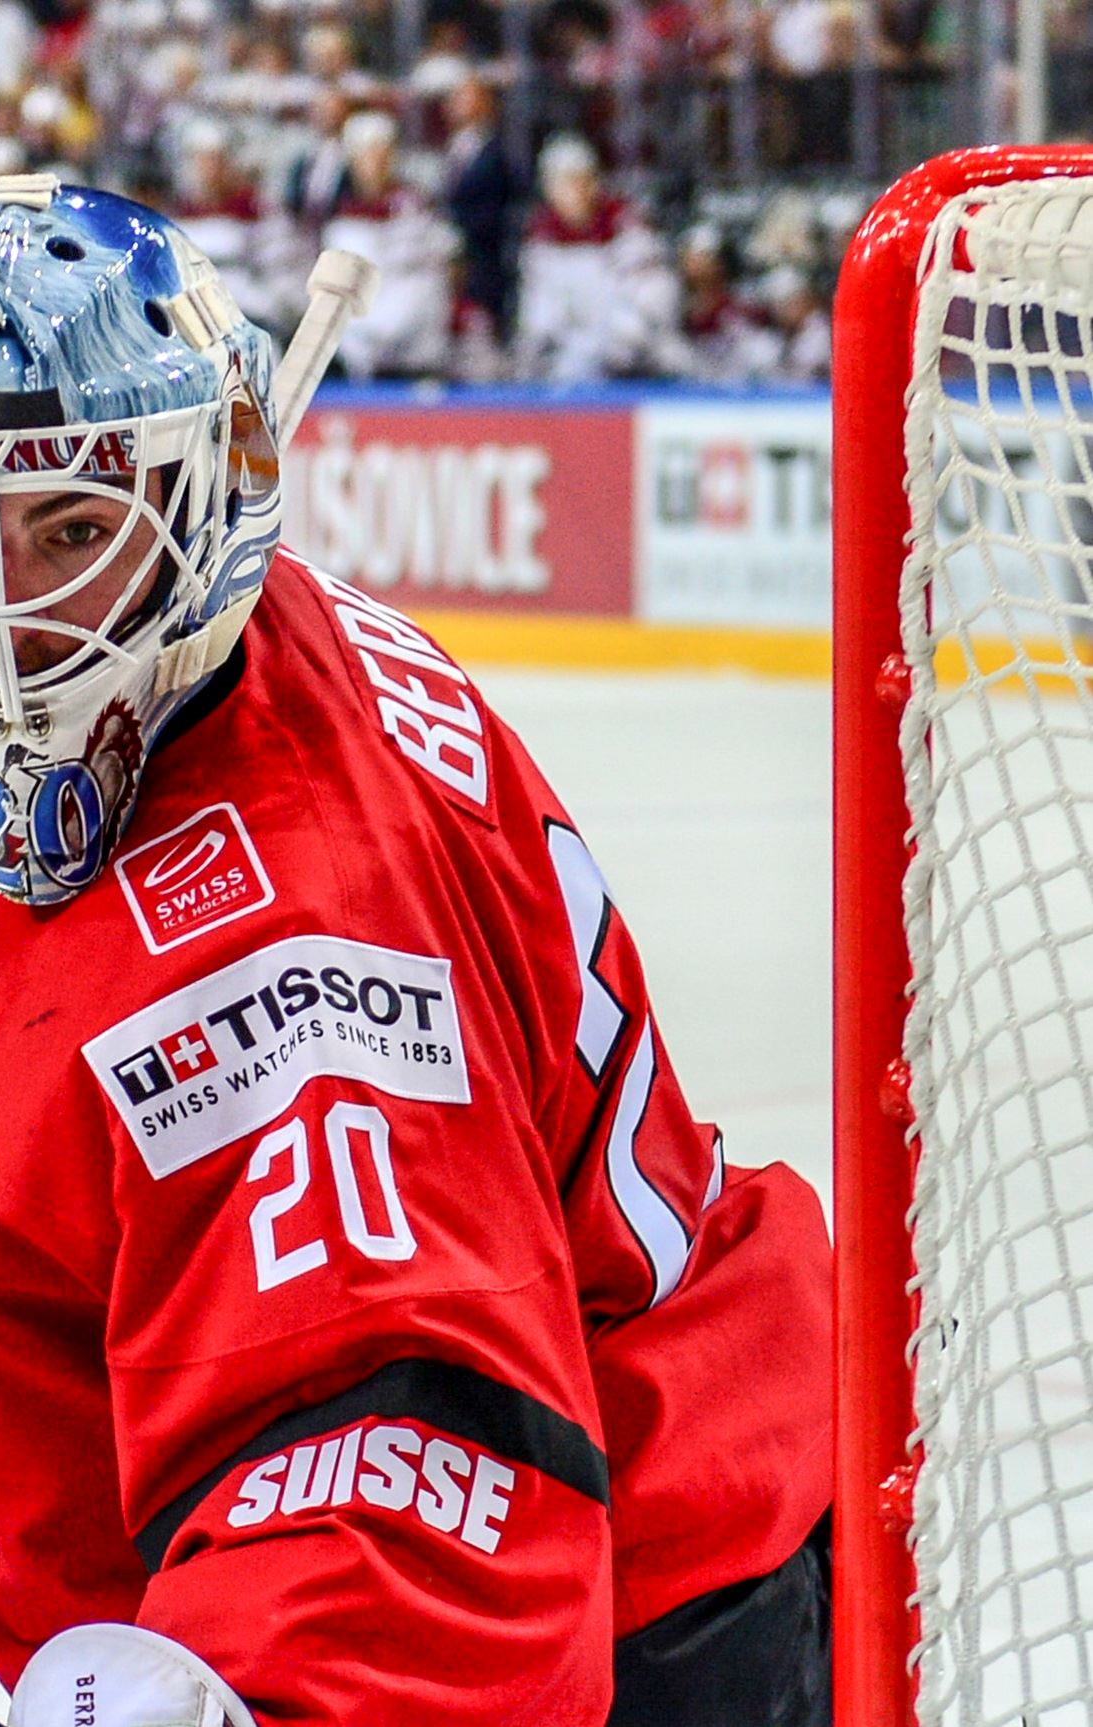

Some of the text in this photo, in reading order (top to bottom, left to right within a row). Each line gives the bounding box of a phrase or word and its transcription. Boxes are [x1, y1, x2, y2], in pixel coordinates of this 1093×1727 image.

[155, 866, 244, 920] SWISS
[163, 884, 248, 930] ICE HOCKEY
[205, 966, 443, 1051] TISSOT
[141, 1019, 452, 1138] SWISS WATCHES SINCE 1853
[246, 1101, 418, 1293] 20
[227, 1425, 515, 1555] SUISSE
[74, 1673, 96, 1727] BERR
